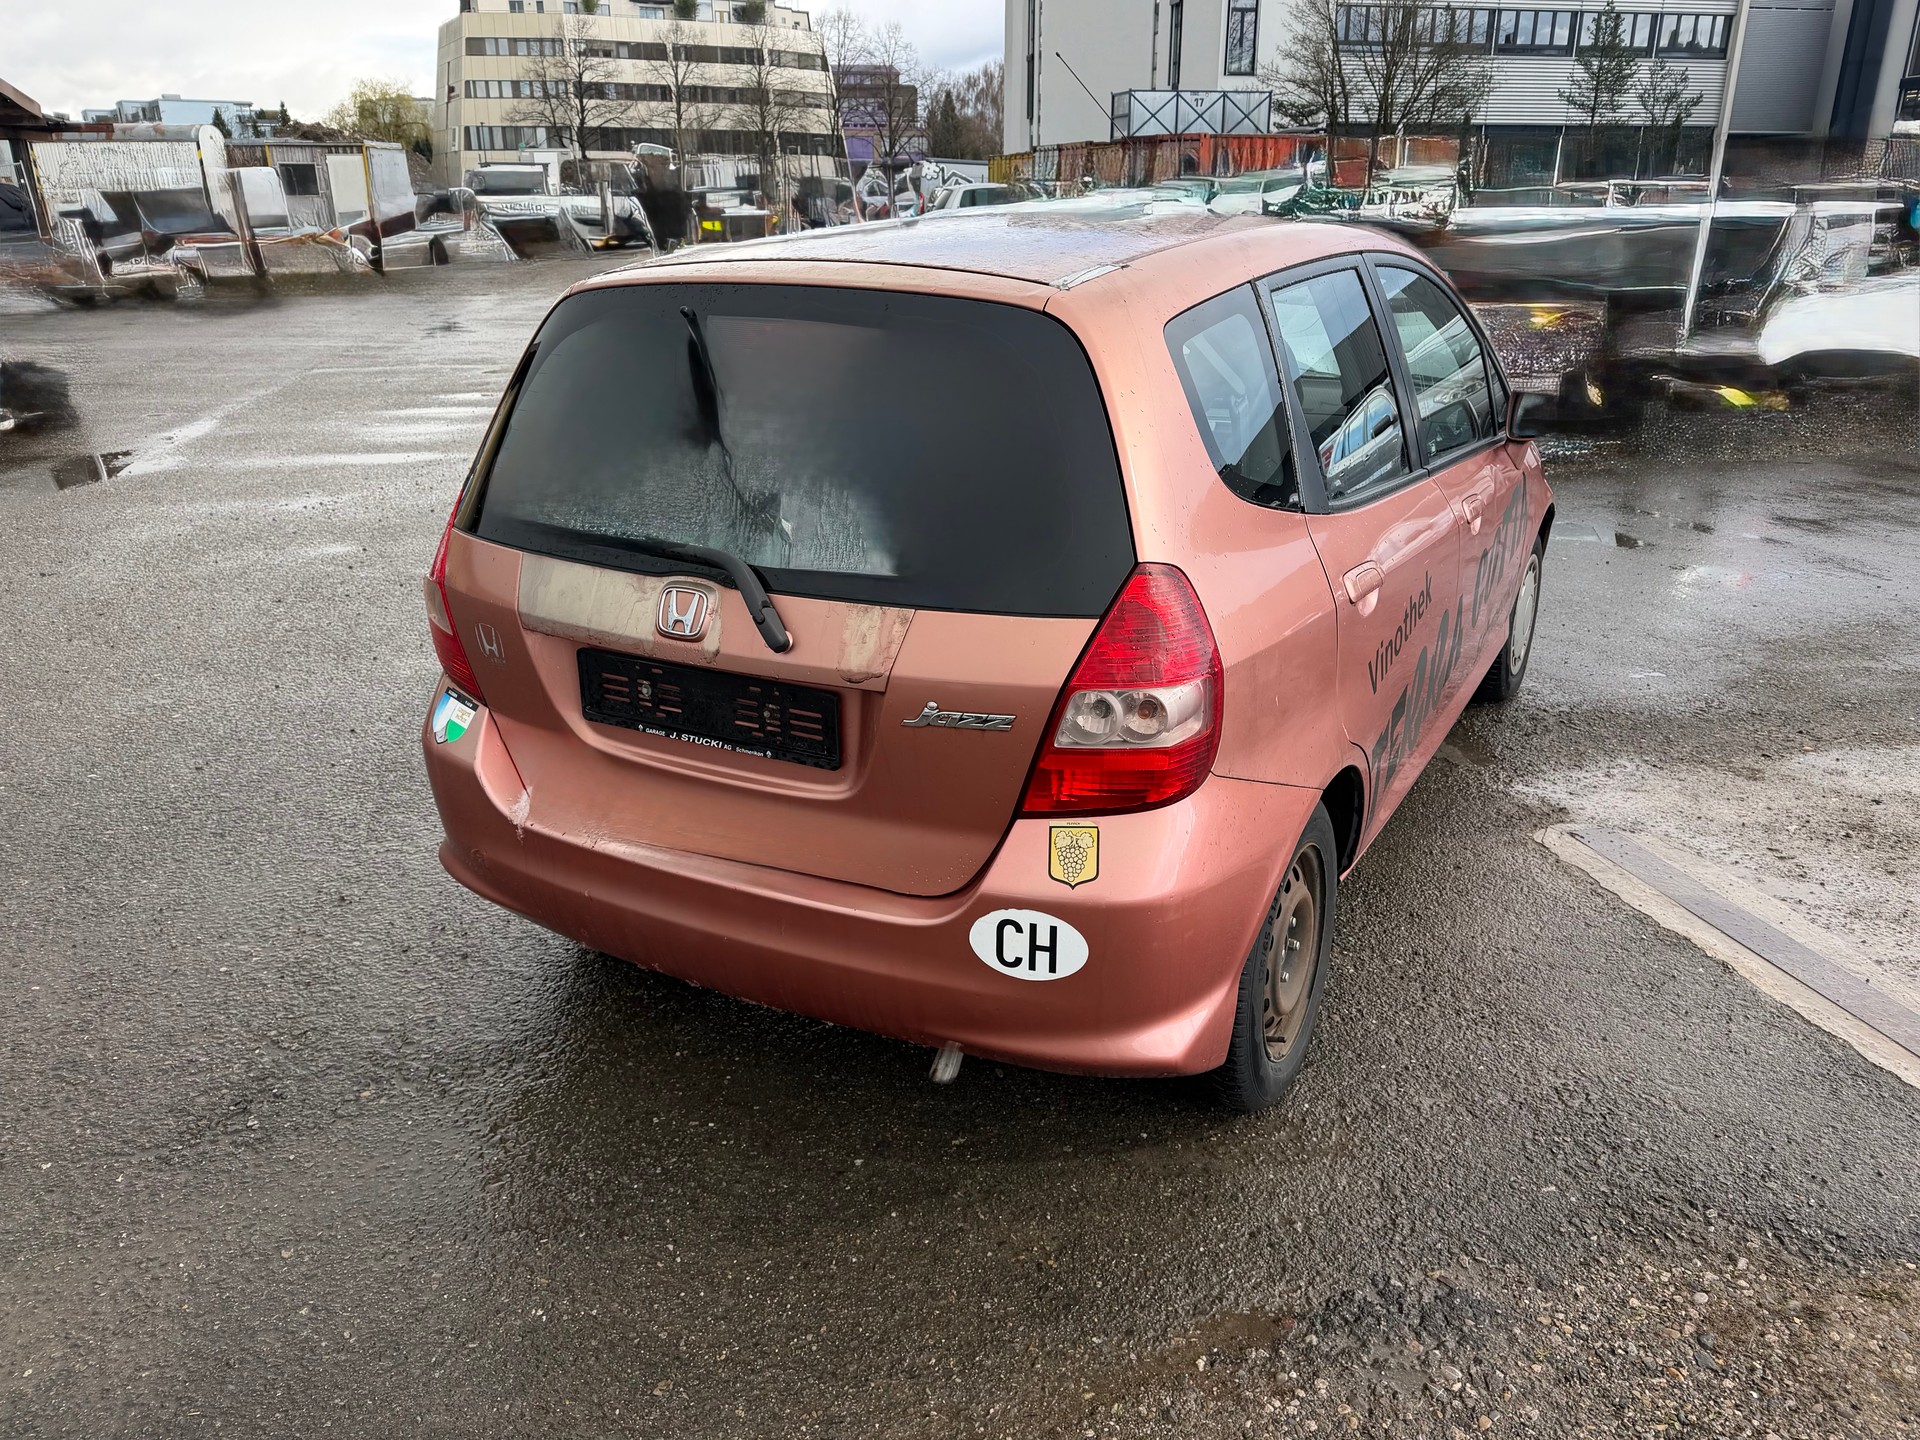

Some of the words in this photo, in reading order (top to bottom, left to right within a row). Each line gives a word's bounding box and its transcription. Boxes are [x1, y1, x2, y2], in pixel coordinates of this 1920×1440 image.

[1193, 97, 1204, 108] 17
[1367, 570, 1433, 695] Vinothek
[900, 700, 1017, 731] jazz
[1369, 593, 1464, 821] TERRA
[645, 727, 666, 737] GARAGE
[669, 731, 679, 740] J.
[680, 733, 723, 748] STUCKI
[995, 918, 1058, 974] CH
